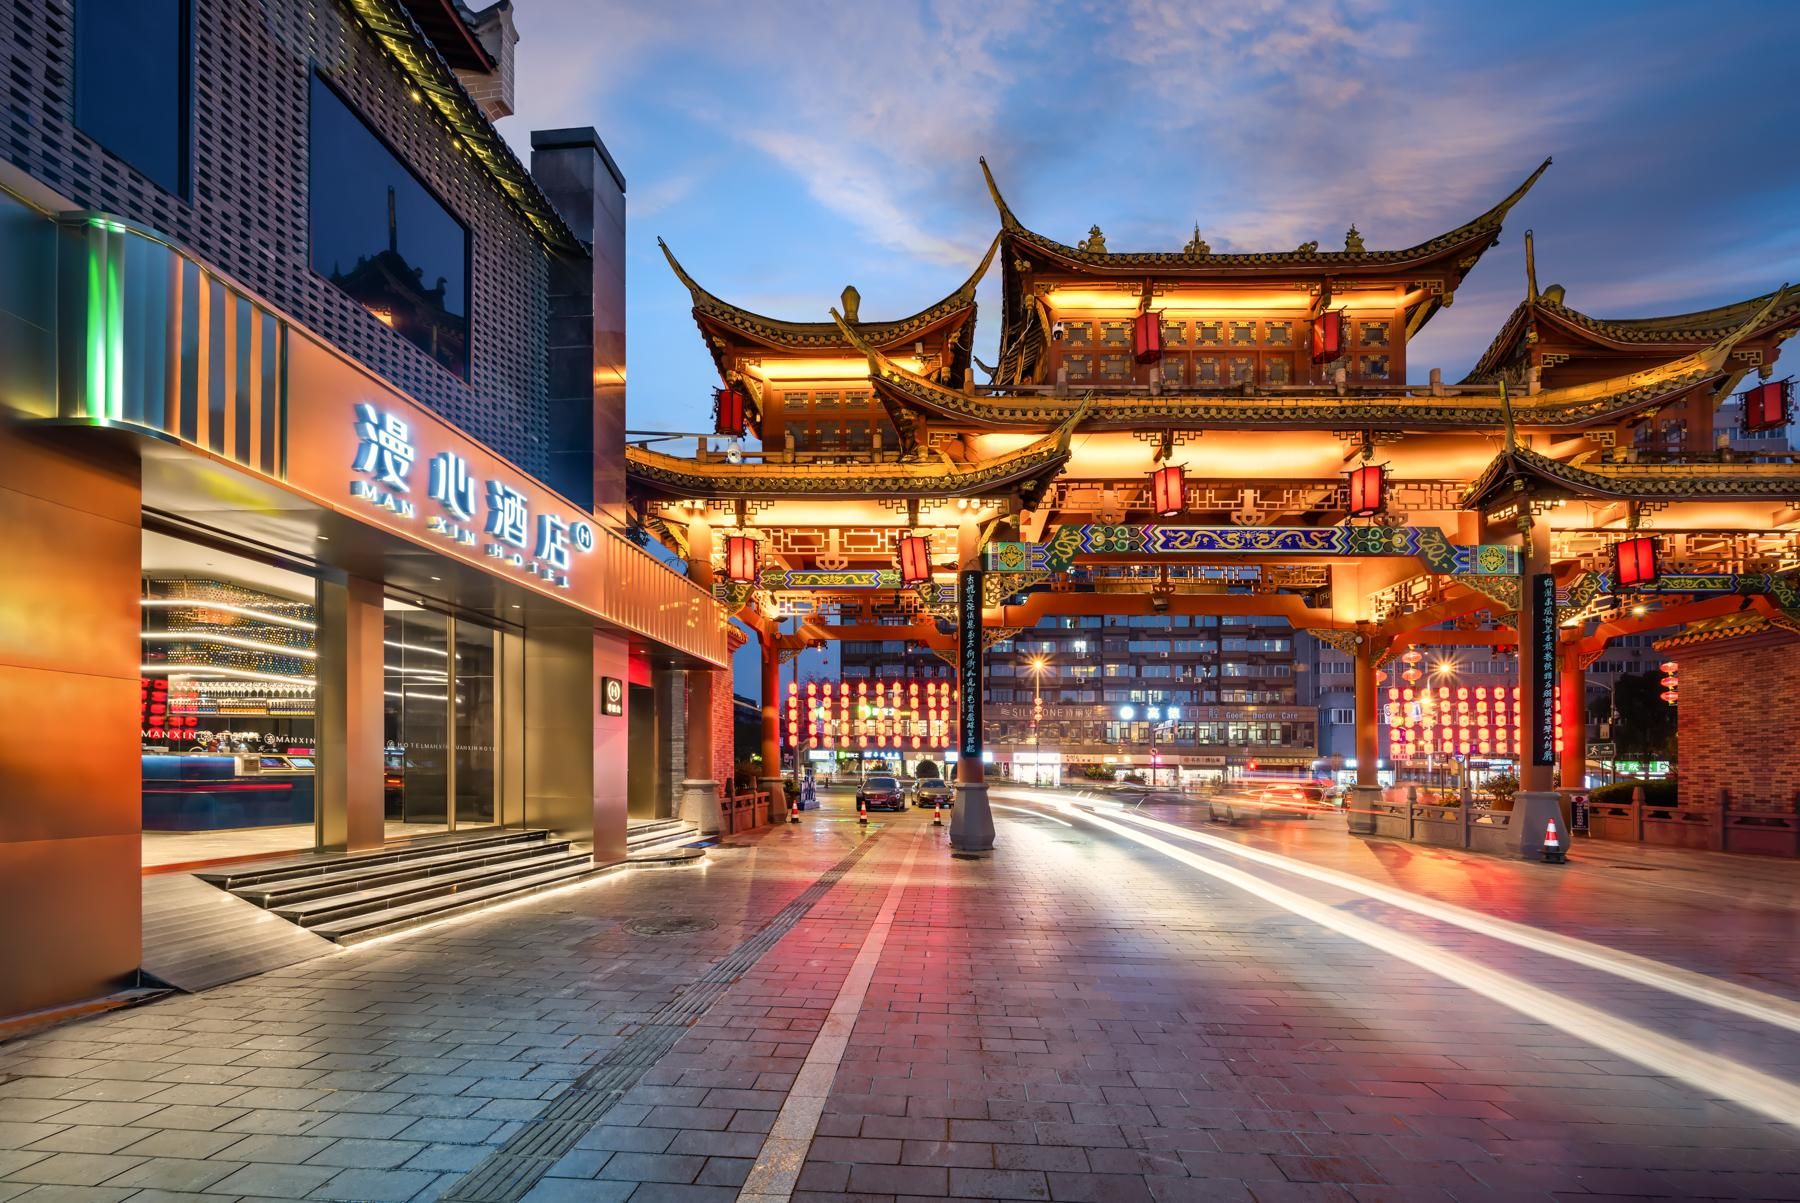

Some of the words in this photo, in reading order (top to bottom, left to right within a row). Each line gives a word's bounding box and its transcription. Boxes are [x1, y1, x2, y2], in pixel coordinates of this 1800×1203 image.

[353, 403, 570, 572] 漫心酒店
[354, 481, 416, 519] MAN
[434, 517, 477, 546] XIN
[488, 545, 570, 588] HOTEL
[141, 728, 197, 740] MANXIN
[276, 735, 317, 746] MANXIN
